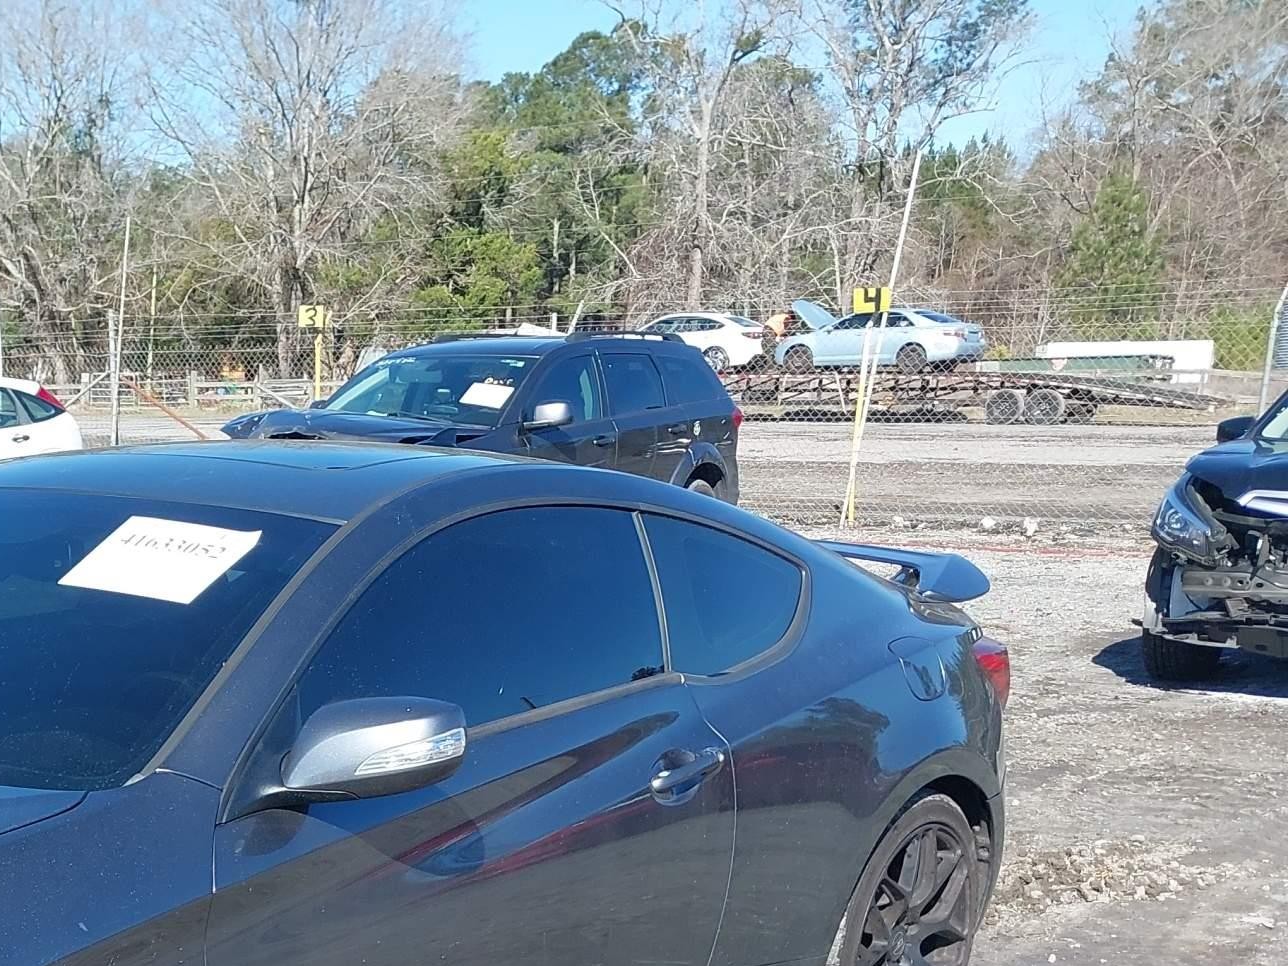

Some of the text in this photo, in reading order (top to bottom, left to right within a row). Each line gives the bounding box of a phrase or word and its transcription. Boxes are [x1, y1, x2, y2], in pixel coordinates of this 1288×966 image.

[863, 287, 882, 311] 4
[304, 307, 318, 327] 3
[120, 533, 227, 559] 41633052
